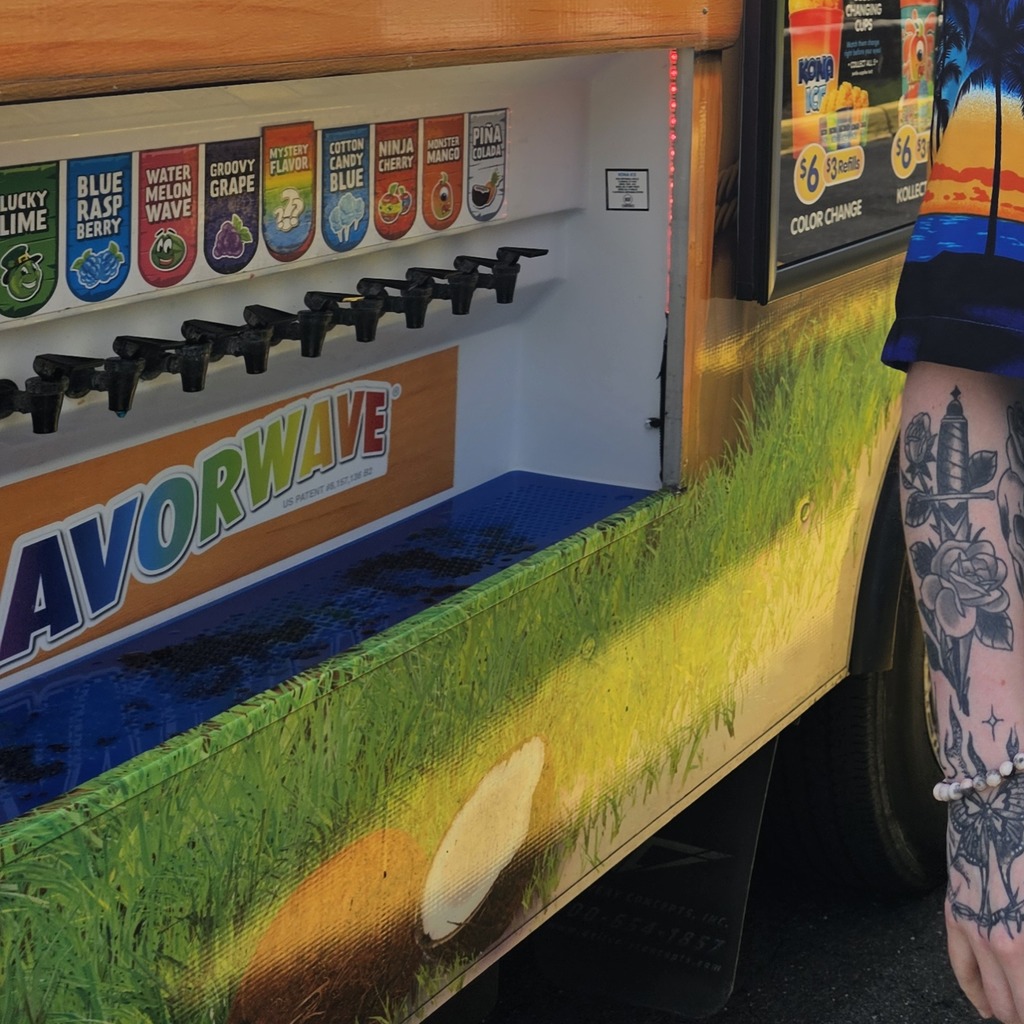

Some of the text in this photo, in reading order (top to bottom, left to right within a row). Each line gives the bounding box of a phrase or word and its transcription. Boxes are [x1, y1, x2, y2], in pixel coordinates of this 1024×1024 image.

[845, 2, 883, 19] CHANGING
[854, 17, 873, 32] CUPS
[798, 54, 835, 85] KONA
[804, 83, 828, 114] ICE
[427, 136, 461, 150] MONSTER
[472, 122, 502, 146] PIÑA
[269, 143, 309, 161] MYSTERY
[329, 138, 364, 155] COTTON
[378, 139, 414, 157] NINJA
[427, 147, 461, 163] MANGO
[472, 142, 502, 160] COLADA
[896, 135, 912, 170] $6
[209, 159, 255, 177] GROOVY
[269, 156, 309, 174] FLAVOR
[329, 153, 364, 170] CANDY
[378, 155, 414, 173] CHERRY
[146, 164, 191, 185] WATER
[329, 169, 364, 192] BLUE
[799, 154, 861, 193] $6 $3 Refills
[77, 171, 123, 198] BLUE
[146, 181, 192, 202] MELON
[210, 176, 255, 197] GRAPE
[0, 190, 48, 212] LUCKY
[77, 194, 123, 222] RASP
[0, 209, 48, 236] LIME
[145, 202, 192, 223] WAVE
[790, 198, 863, 236] COLOR CHANGE
[76, 218, 122, 240] BERRY
[282, 497, 294, 509] US
[295, 485, 325, 503] PATENT
[0, 388, 390, 665] AVORWAVE
